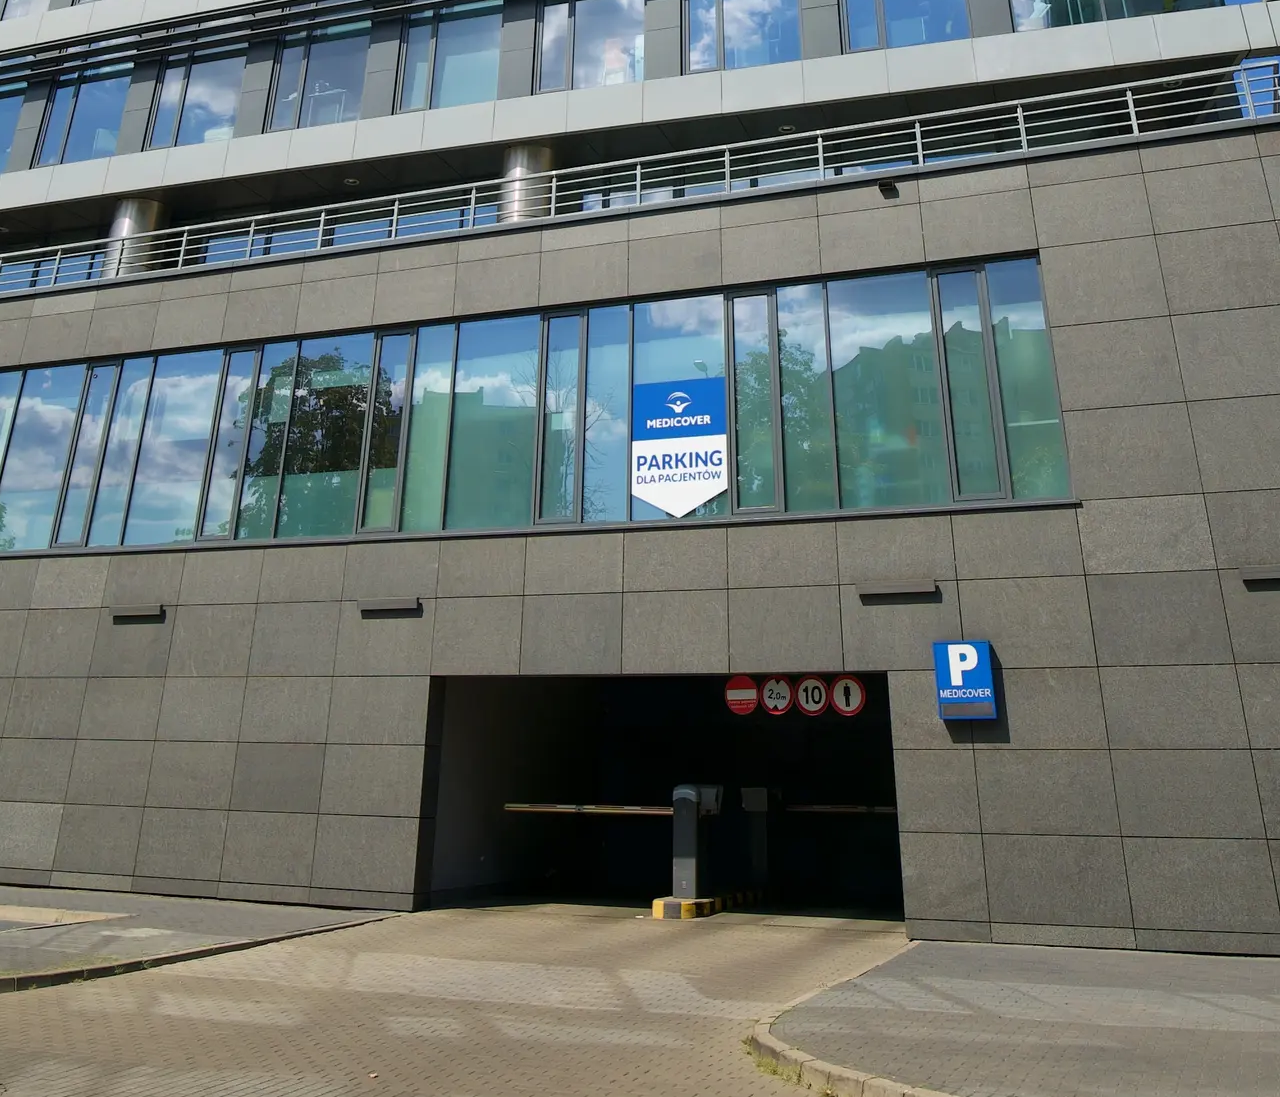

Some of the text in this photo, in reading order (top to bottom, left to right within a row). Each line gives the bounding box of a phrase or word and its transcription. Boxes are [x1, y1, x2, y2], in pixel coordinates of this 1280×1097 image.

[646, 414, 711, 429] MEDICOVER
[636, 449, 723, 472] PARKING
[636, 470, 722, 485] DLA PACJENTÓW
[947, 644, 979, 687] P
[768, 688, 787, 701] 2,0m
[803, 685, 823, 705] 10
[939, 688, 992, 698] MEDICOVER
